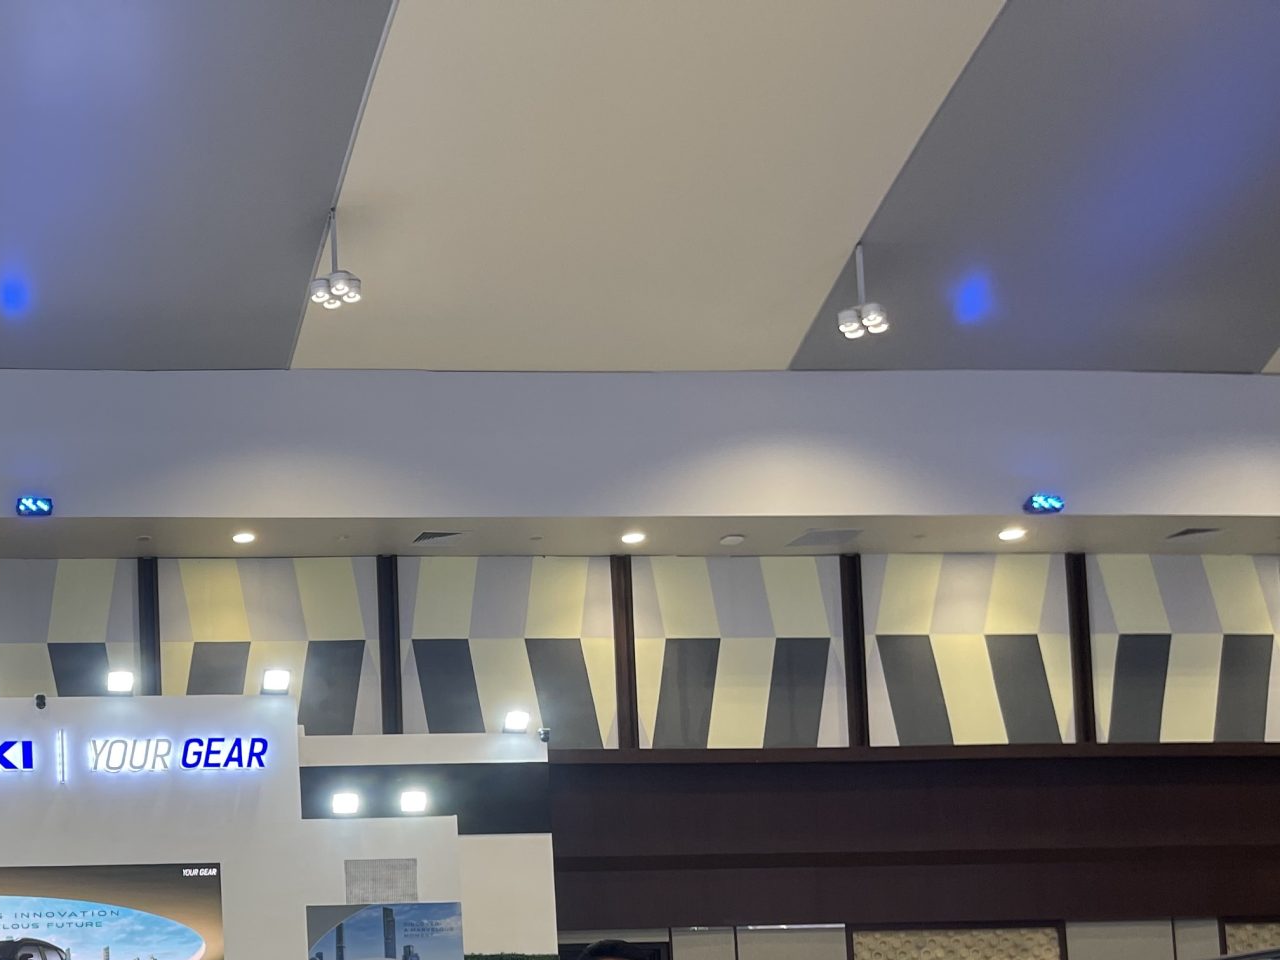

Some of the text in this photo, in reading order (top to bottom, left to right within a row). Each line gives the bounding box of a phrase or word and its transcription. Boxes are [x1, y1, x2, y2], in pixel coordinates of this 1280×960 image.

[89, 737, 269, 772] YOUR GEAR
[182, 868, 217, 877] YOUR GEAR
[14, 909, 120, 919] INNOVATION
[47, 921, 103, 929] FUTURE
